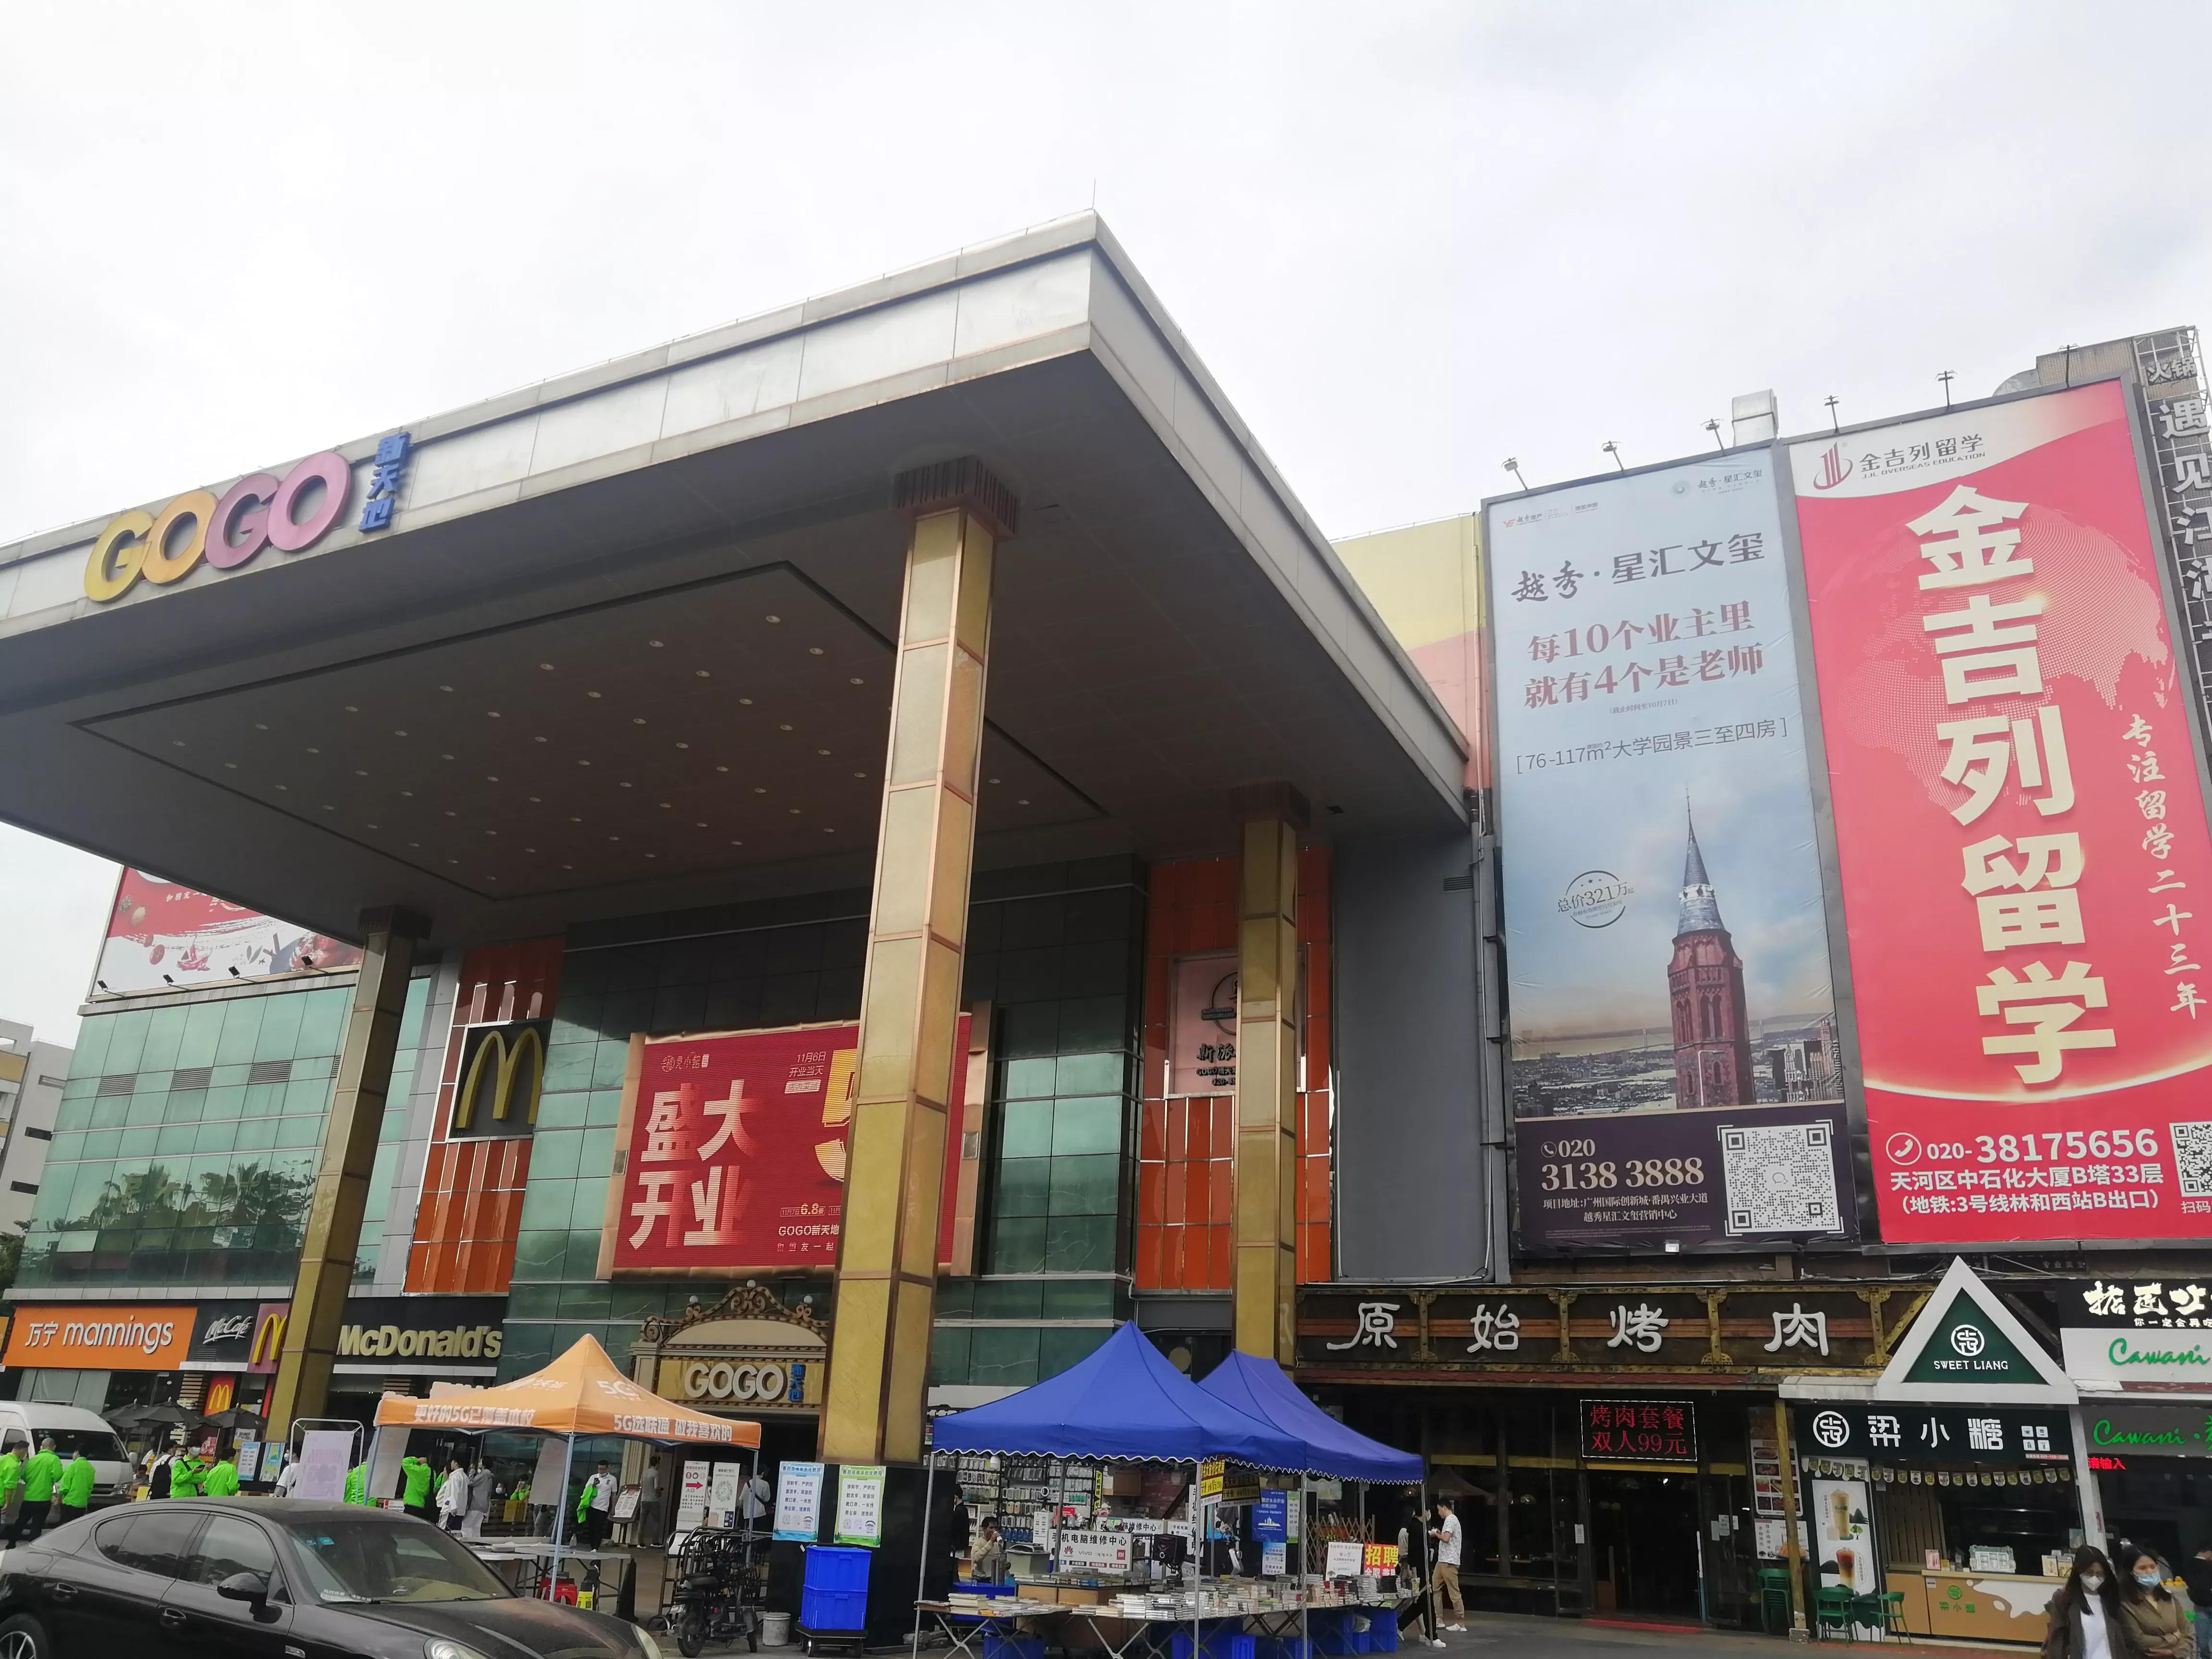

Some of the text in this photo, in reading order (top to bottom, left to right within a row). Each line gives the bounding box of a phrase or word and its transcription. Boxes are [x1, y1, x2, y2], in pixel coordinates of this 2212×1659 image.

[2147, 356, 2198, 383] 火锅
[1859, 433, 1984, 472] 金吉列留学
[1881, 463, 1931, 475] OVERSEAS
[1933, 452, 1986, 466] EDUCATION
[359, 431, 411, 533] 新天地
[84, 451, 351, 602] GOGO
[1511, 532, 1765, 602] 越秀·星汇文玺
[1527, 600, 1755, 664] 每10个业主里
[1523, 641, 1764, 709] 就有4个是老师
[1906, 484, 2116, 1084] 金吉列留学
[2122, 713, 2207, 1020] 专注留学二十三年
[789, 1065, 824, 1077] 开业当天
[640, 1078, 756, 1162] 盛大
[1558, 1139, 1595, 1157] 020
[1926, 1129, 2159, 1163] 020-38175656
[1541, 1157, 1705, 1191] 3138 3888
[1890, 1163, 2164, 1191] 天河区中石化大厦B塔33层
[629, 1165, 755, 1250] 开业
[1583, 1209, 1677, 1223] 越秀星汇文玺营销中心
[1902, 1189, 2159, 1214] (地铁:3号线林和西站B出口)
[25, 1315, 174, 1354] 万宁 mannings
[337, 1324, 503, 1358] McDonald's
[1327, 1301, 1829, 1356] 原始烤肉
[1934, 1359, 2009, 1370] SWEET LIANG
[2108, 1337, 2211, 1366] Cawani
[685, 1364, 784, 1400] GOGO
[1590, 1405, 1684, 1430] 烤肉套餐
[2093, 1419, 2187, 1446] Cawani
[1591, 1431, 1687, 1455] 双人99元
[1365, 1545, 1399, 1567] 招聘
